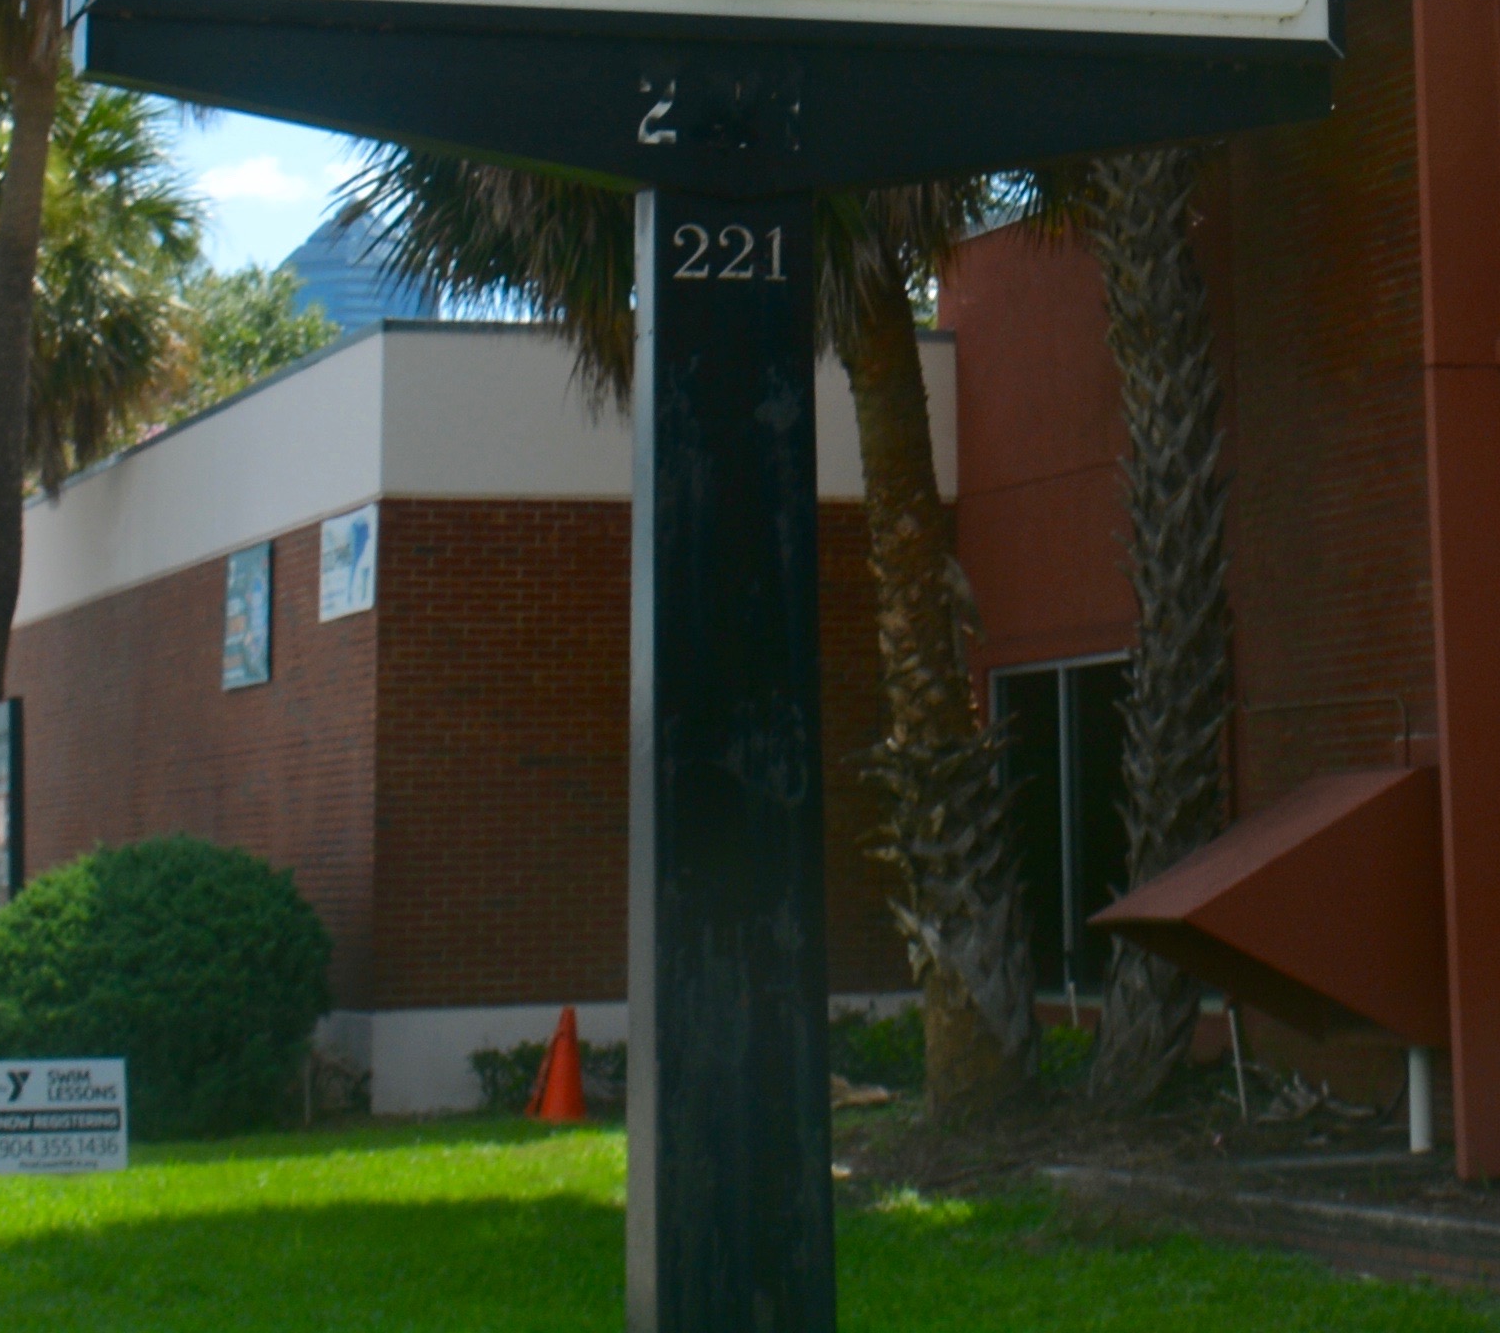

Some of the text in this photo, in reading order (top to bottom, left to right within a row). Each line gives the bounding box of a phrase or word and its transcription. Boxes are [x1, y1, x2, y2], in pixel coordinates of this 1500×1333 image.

[672, 223, 788, 281] 221
[47, 1068, 90, 1085] SWIM
[47, 1084, 118, 1102] LESSONS
[33, 1111, 119, 1130] REGISTERING
